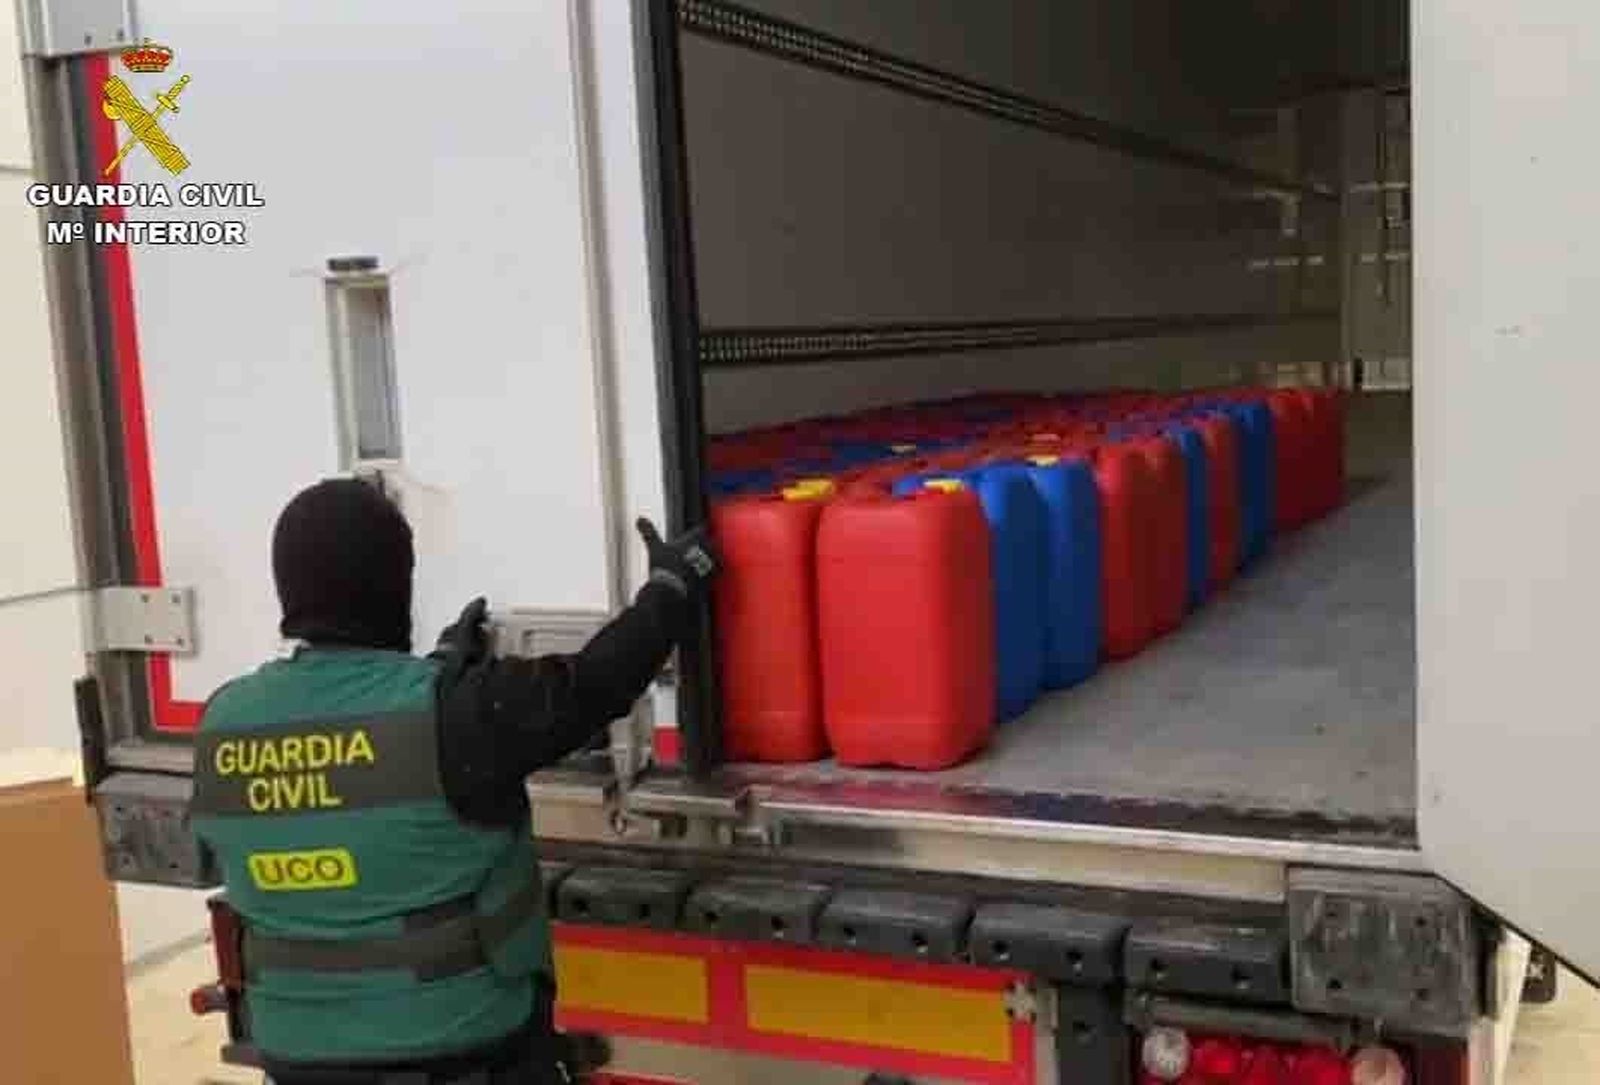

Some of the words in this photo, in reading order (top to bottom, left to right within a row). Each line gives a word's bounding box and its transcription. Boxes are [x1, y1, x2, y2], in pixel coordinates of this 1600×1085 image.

[215, 730, 375, 776] GUARDIA
[248, 773, 344, 812] CIVIL
[255, 855, 344, 884] UCO
